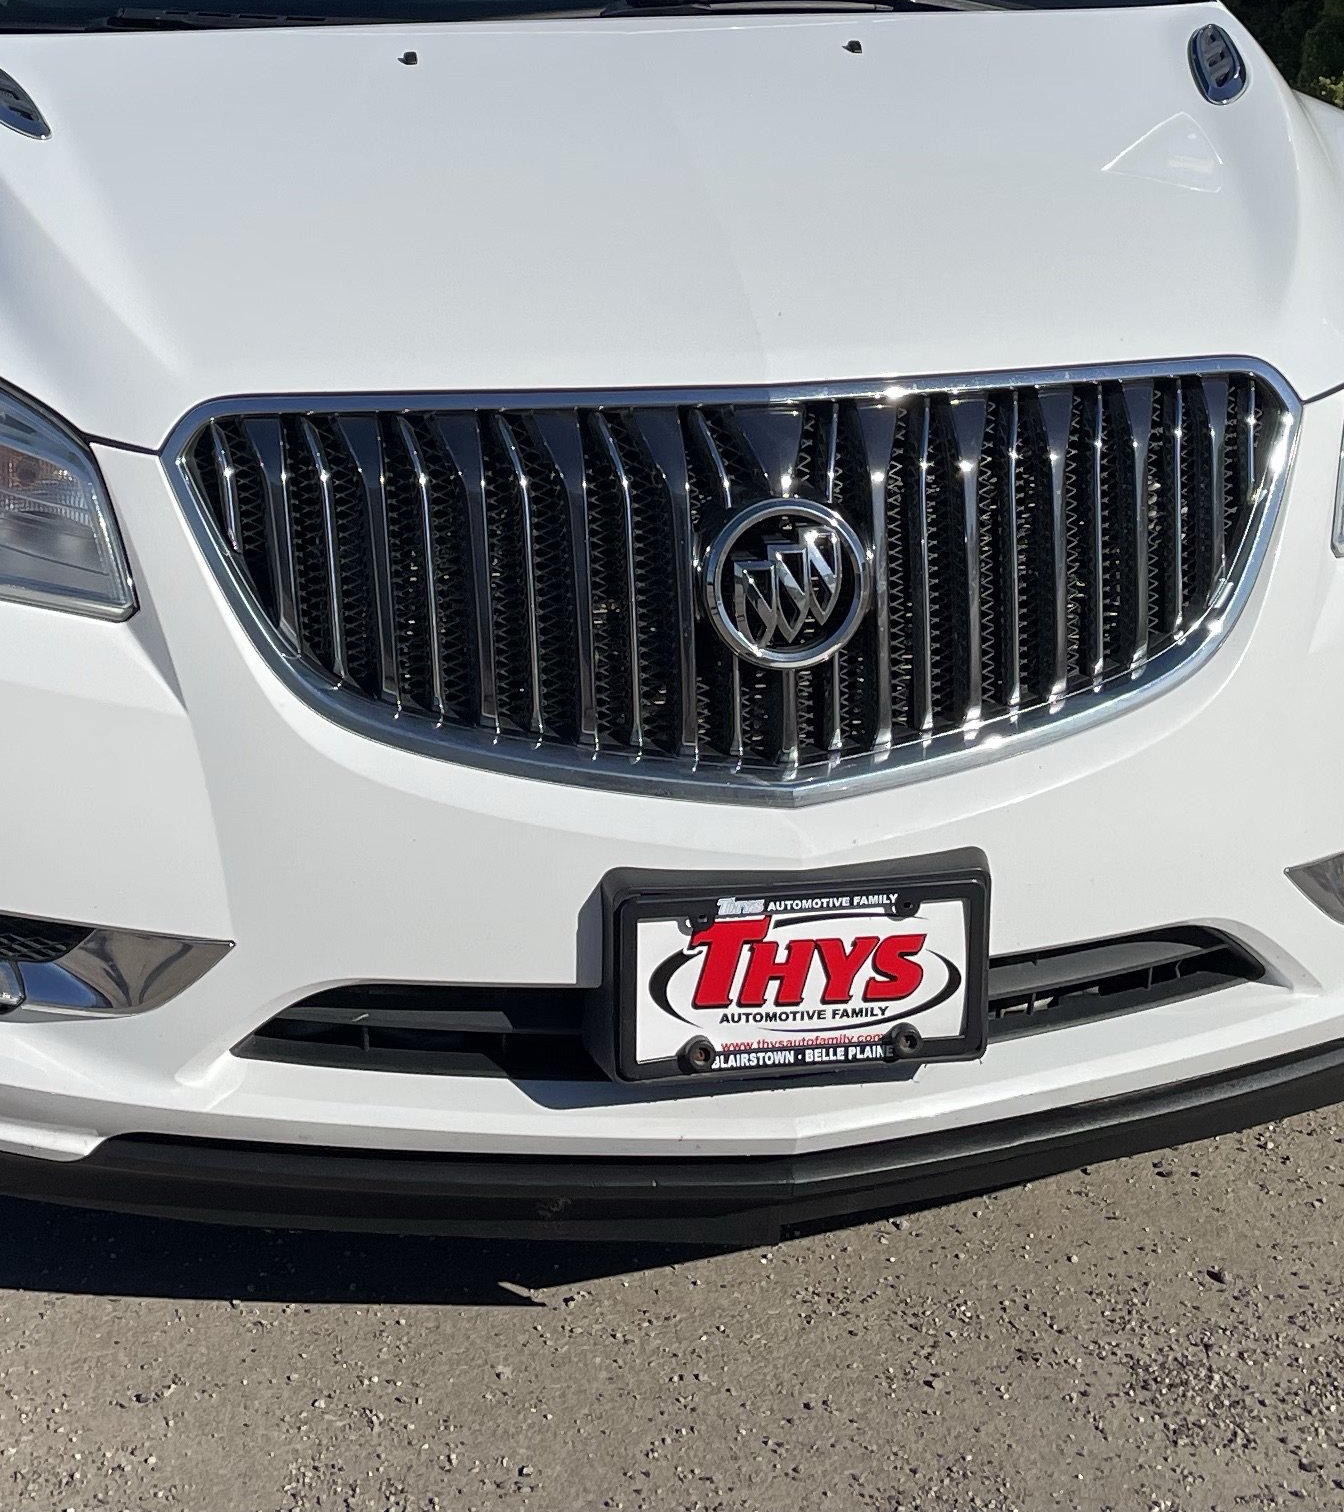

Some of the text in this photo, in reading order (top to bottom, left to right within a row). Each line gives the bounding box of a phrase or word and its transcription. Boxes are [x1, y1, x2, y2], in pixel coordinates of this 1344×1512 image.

[767, 896, 850, 912] AUTOMOTIVE
[853, 893, 899, 906] FAMILY
[688, 915, 928, 1010] THYS
[719, 1005, 890, 1025] AUTOMOTIVE FAMILY
[805, 1047, 845, 1062] BELLE
